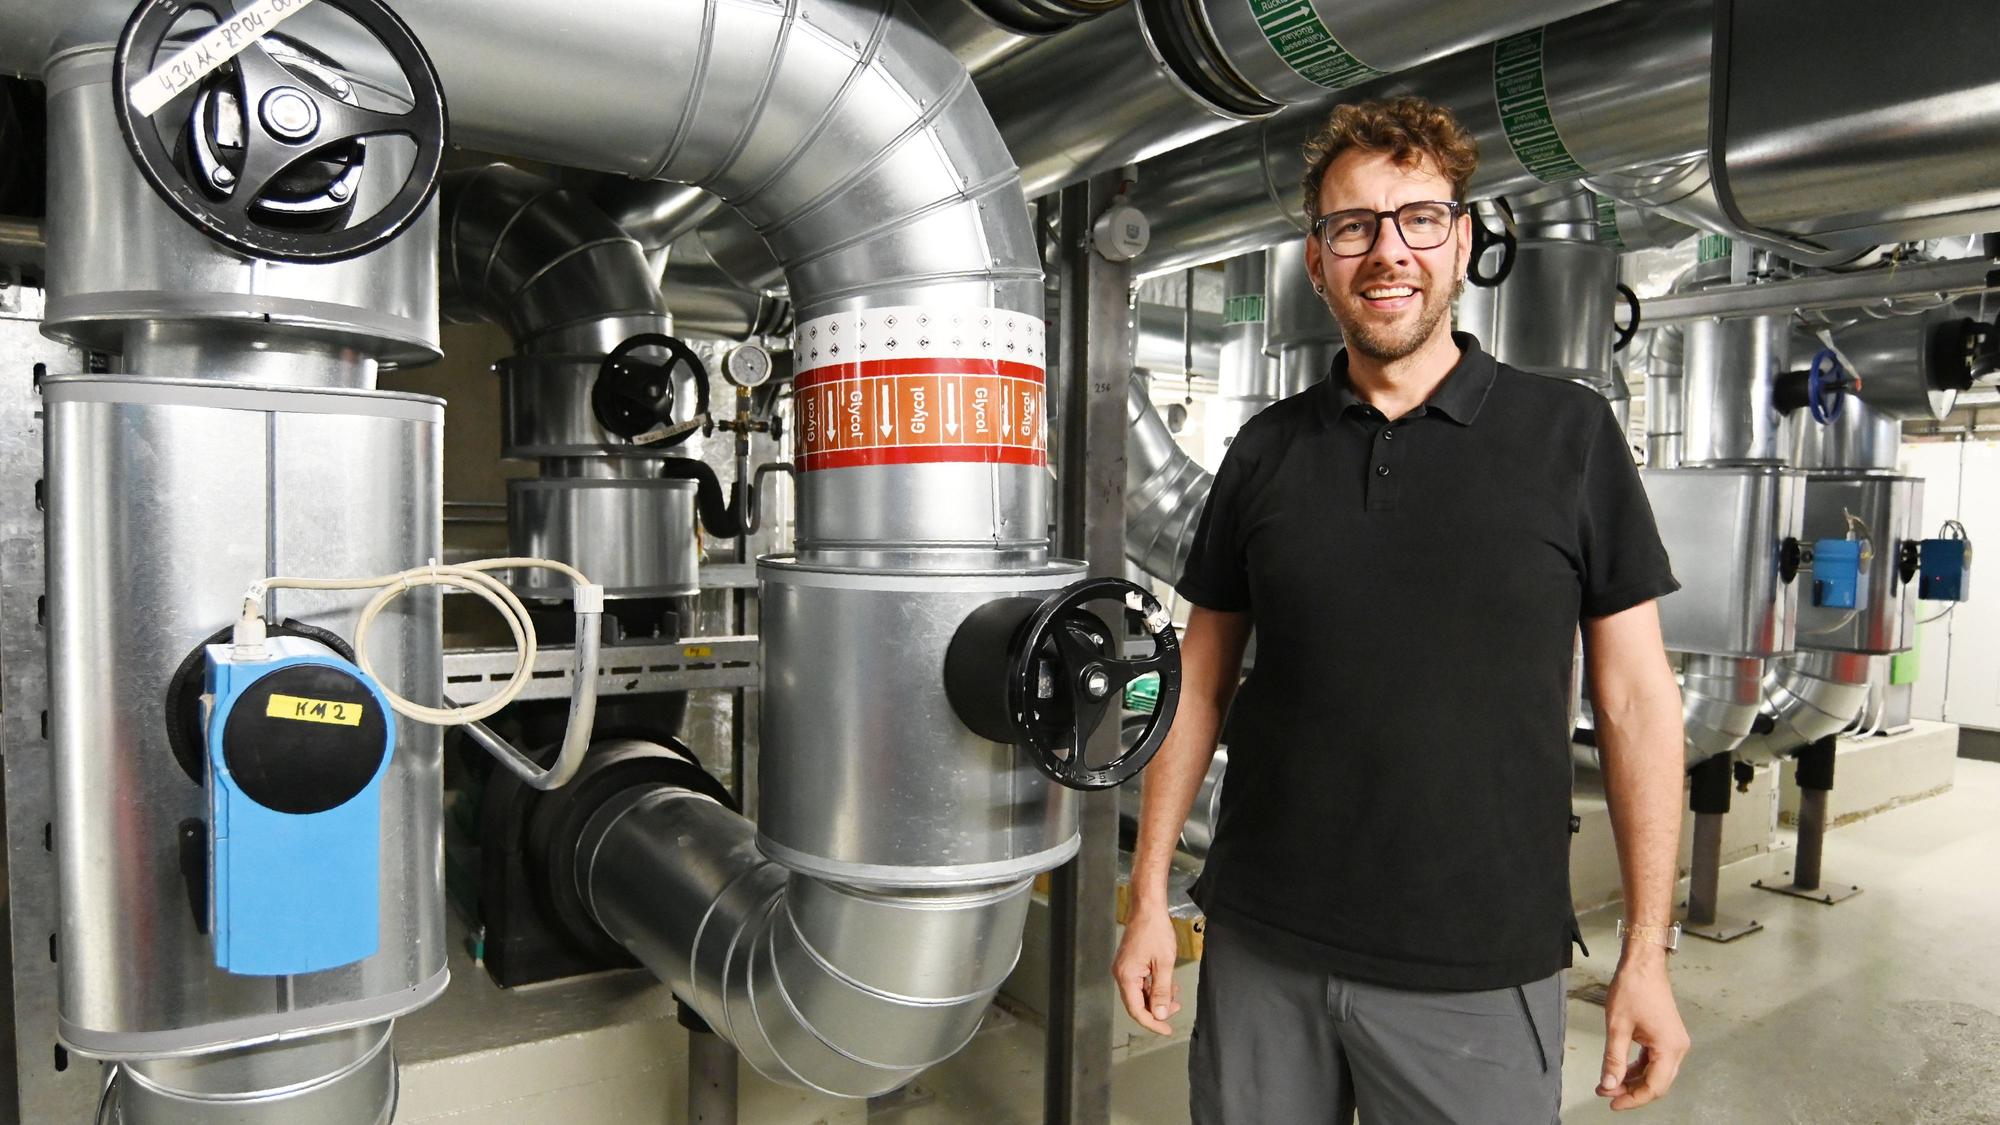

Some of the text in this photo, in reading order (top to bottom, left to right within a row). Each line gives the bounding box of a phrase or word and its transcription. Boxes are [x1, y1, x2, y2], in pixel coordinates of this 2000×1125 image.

[807, 397, 815, 442] Glycol
[848, 390, 863, 439] Glycol
[910, 386, 929, 434] Glycol
[972, 387, 988, 434] Glycol
[1021, 391, 1031, 437] Glycol
